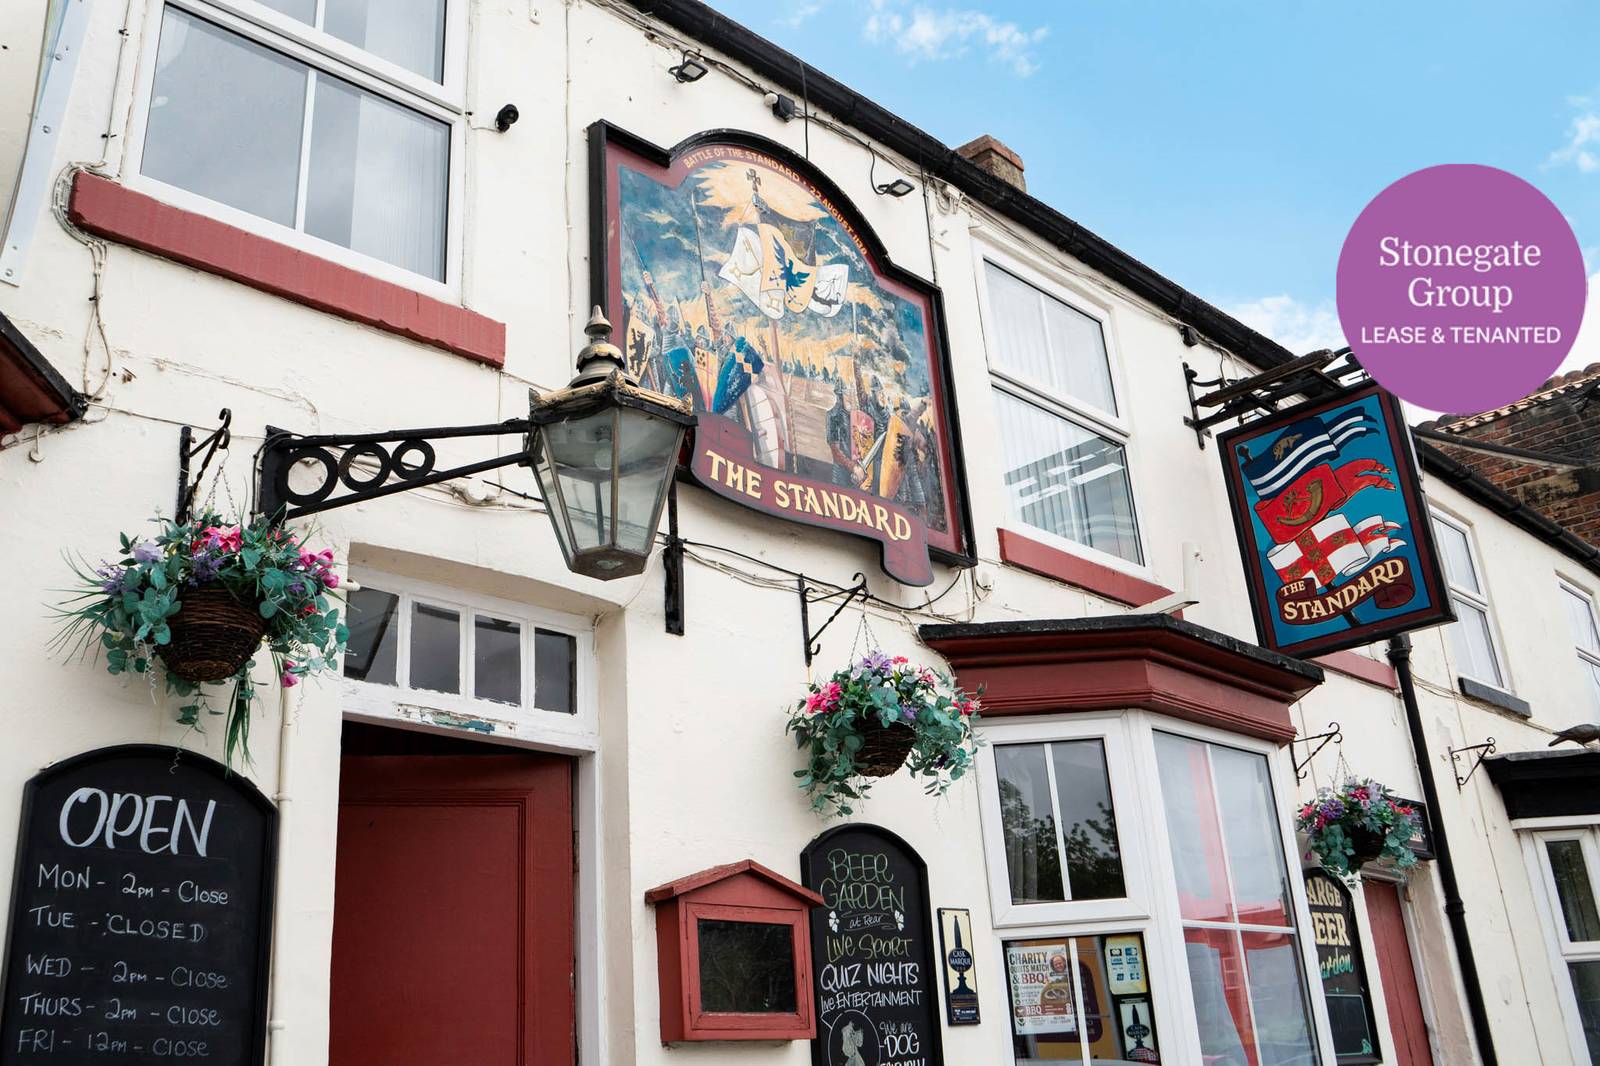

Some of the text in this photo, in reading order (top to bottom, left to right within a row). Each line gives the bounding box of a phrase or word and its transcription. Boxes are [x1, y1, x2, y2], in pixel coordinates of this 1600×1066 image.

[683, 149, 713, 168] BATTLE
[714, 148, 725, 158] OF
[727, 148, 744, 157] THE
[745, 151, 800, 181] STANDARD
[810, 185, 822, 199] 22
[822, 198, 854, 233] AUGUST
[705, 449, 913, 542] THE STANDARD
[1281, 580, 1306, 597] THE
[1282, 559, 1405, 621] STANDARD
[59, 787, 217, 857] OPEN
[828, 848, 894, 883] BEER
[38, 863, 90, 890] MON
[178, 880, 229, 905] Close
[820, 877, 905, 912] GARDEN
[1306, 876, 1342, 907] ARGE
[29, 904, 75, 928] TUE
[108, 914, 205, 943] CLOSED
[849, 914, 884, 929] at Rear
[1311, 911, 1351, 946] EER
[26, 953, 72, 978] WED
[952, 950, 966, 958] CASK
[1009, 952, 1048, 966] CHARITY
[1030, 963, 1050, 972] MATCH
[1320, 947, 1354, 979] arden
[820, 961, 920, 993] QUIZ NIGHTS
[1012, 974, 1020, 984] &
[1021, 972, 1046, 984] BBQ
[20, 992, 82, 1017] THURS
[836, 989, 923, 1009] ENTERTAINMENT
[18, 1029, 55, 1053] FRI
[883, 1032, 920, 1058] DOG
